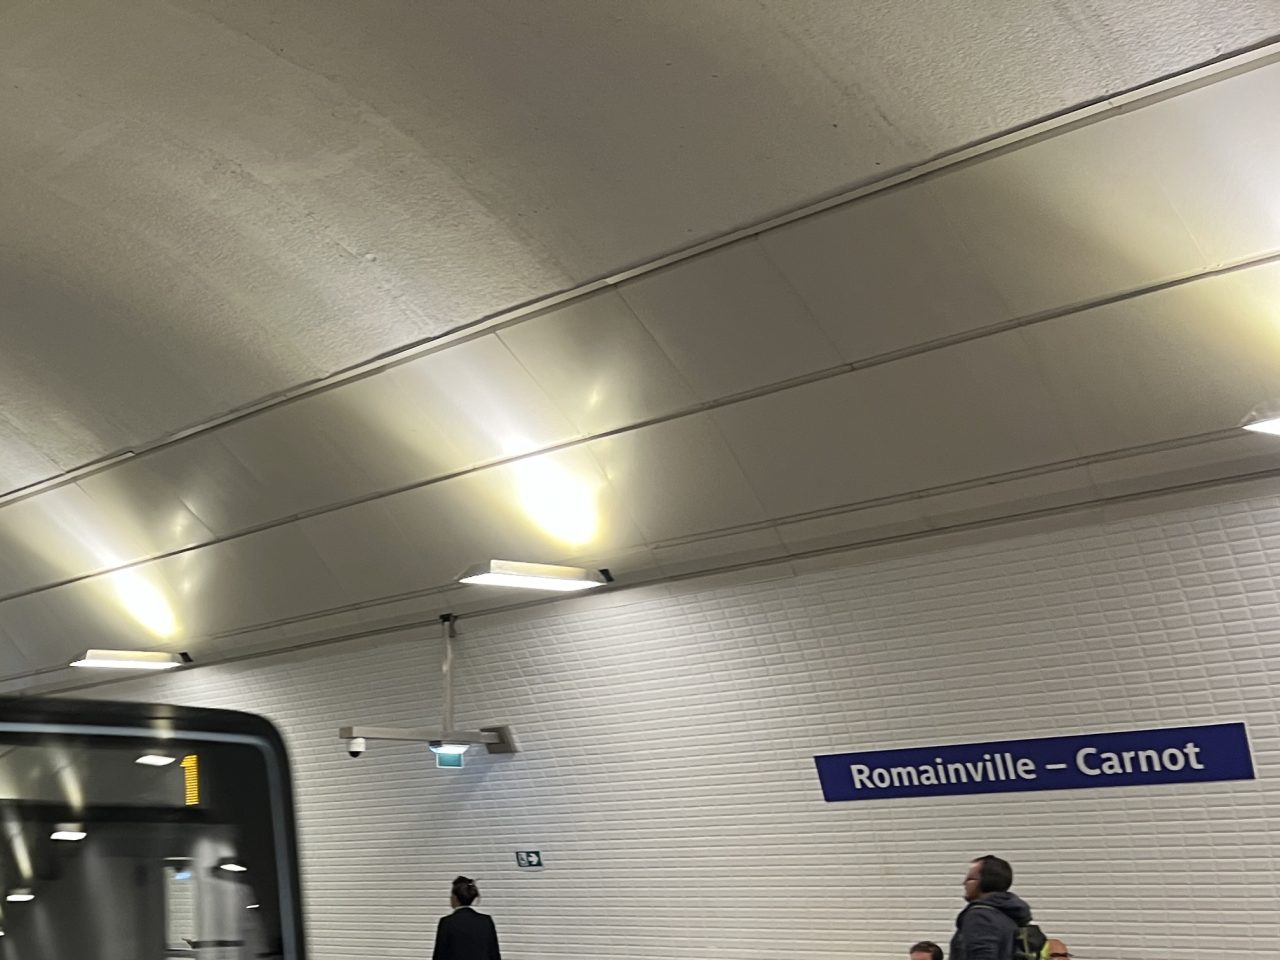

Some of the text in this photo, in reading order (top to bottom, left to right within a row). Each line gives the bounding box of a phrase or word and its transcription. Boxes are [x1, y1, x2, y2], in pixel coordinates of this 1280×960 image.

[180, 755, 199, 805] 1
[850, 753, 1037, 789] Romainville
[1075, 742, 1204, 777] Carnot
